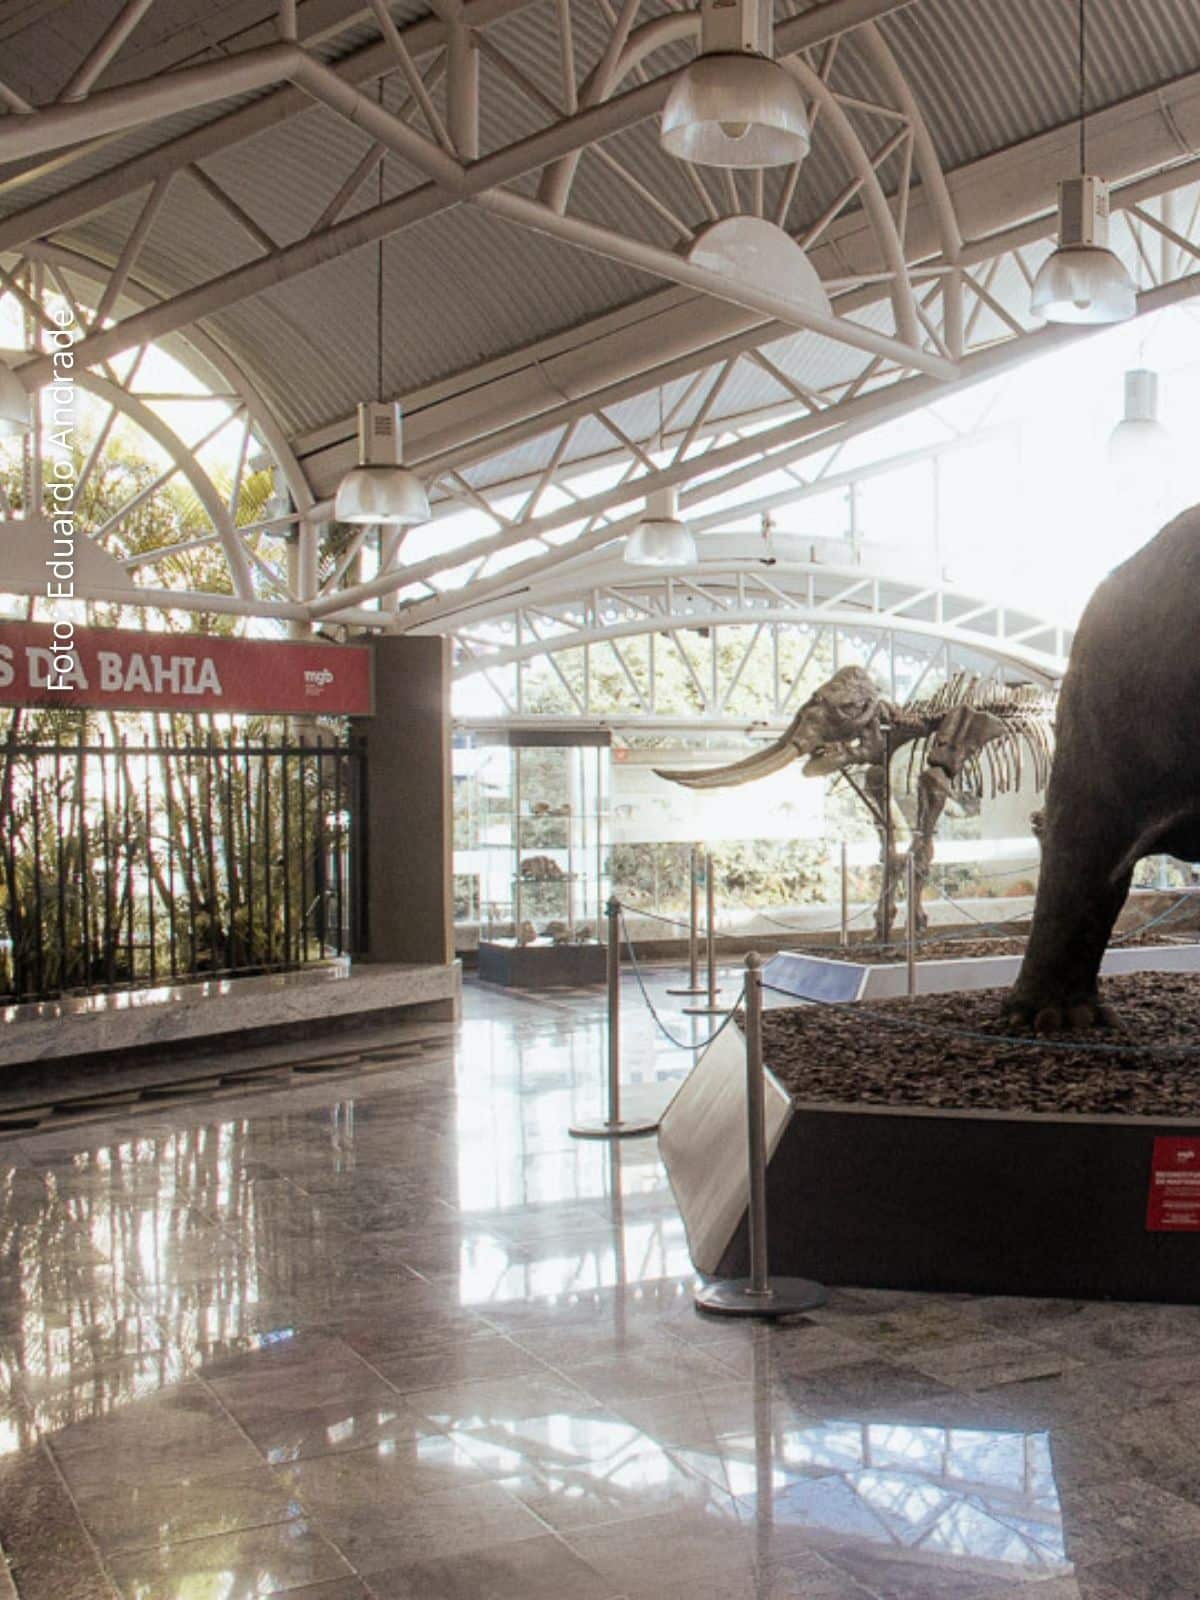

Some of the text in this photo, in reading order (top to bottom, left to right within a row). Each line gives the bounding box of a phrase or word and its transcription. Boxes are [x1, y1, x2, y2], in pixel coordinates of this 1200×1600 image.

[25, 646, 89, 690] DA
[97, 651, 223, 696] BAHIA
[304, 668, 334, 686] mgb
